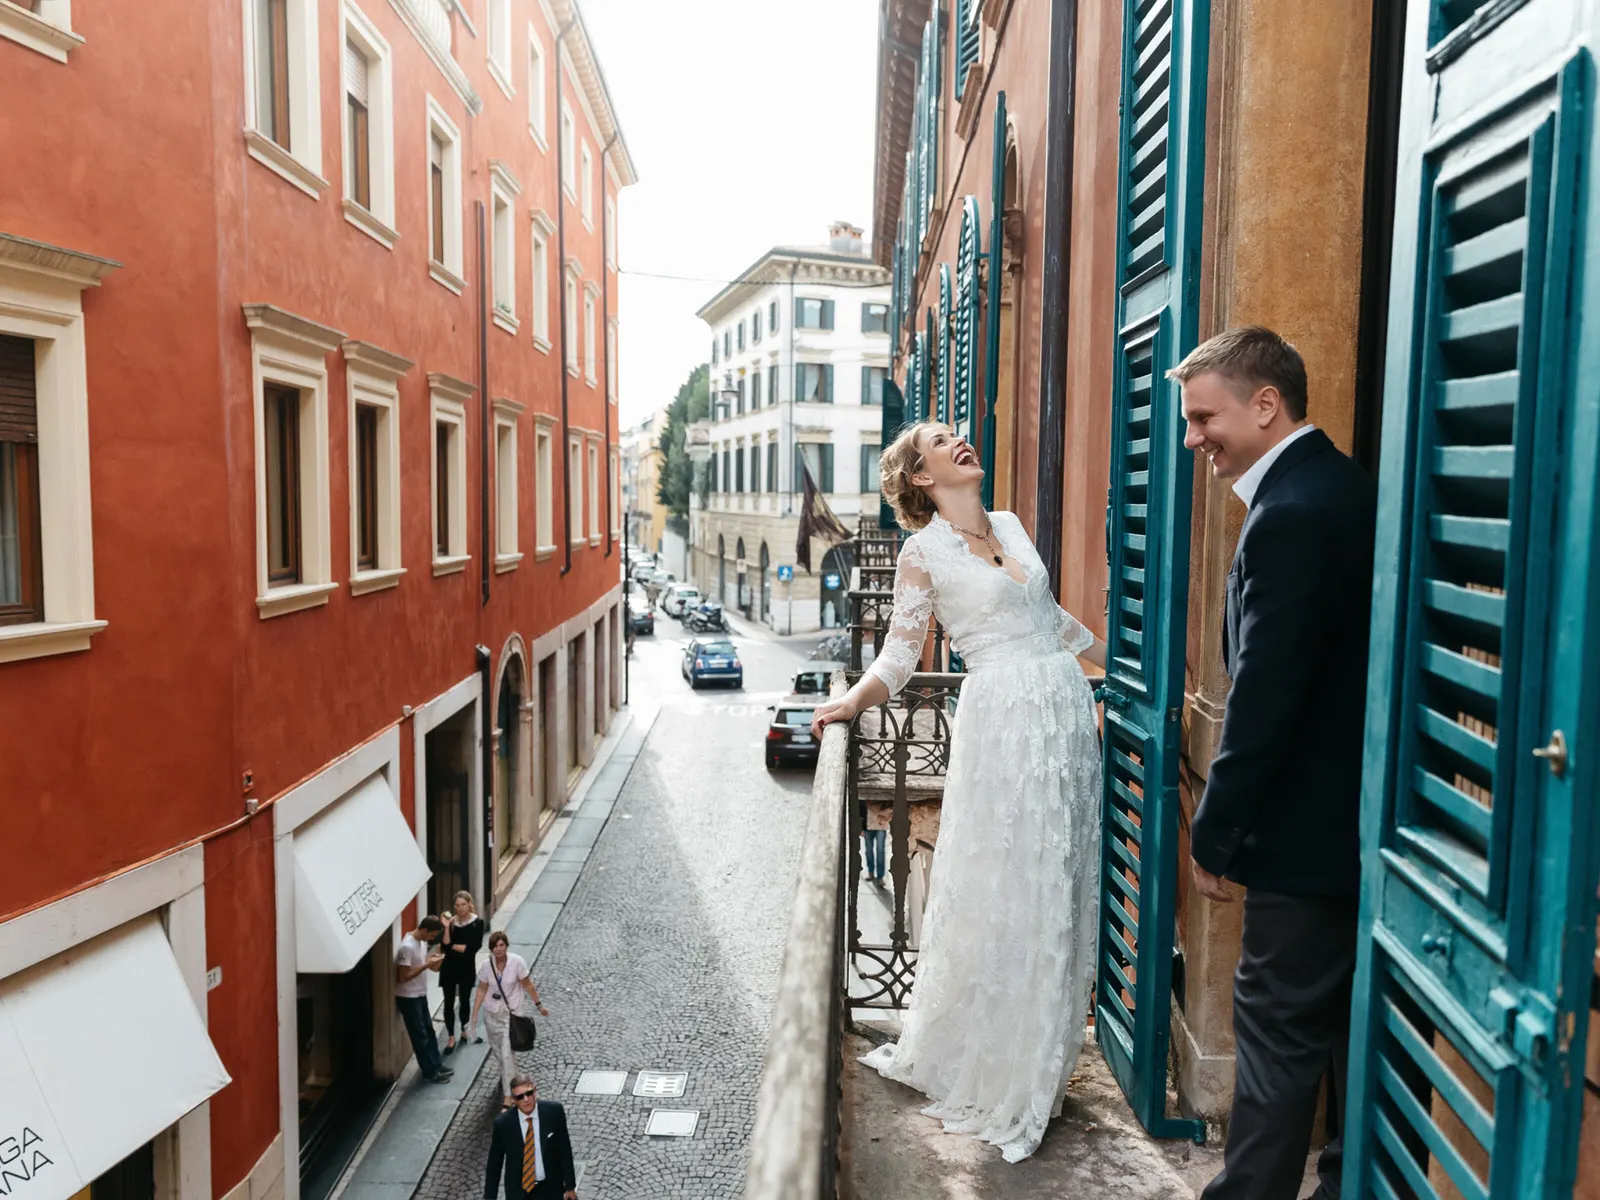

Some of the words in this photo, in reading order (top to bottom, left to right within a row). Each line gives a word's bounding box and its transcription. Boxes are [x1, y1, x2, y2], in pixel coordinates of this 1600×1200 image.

[336, 878, 377, 922] BOTTEGA
[344, 892, 383, 936] GIULIANA
[0, 1127, 43, 1165] GA
